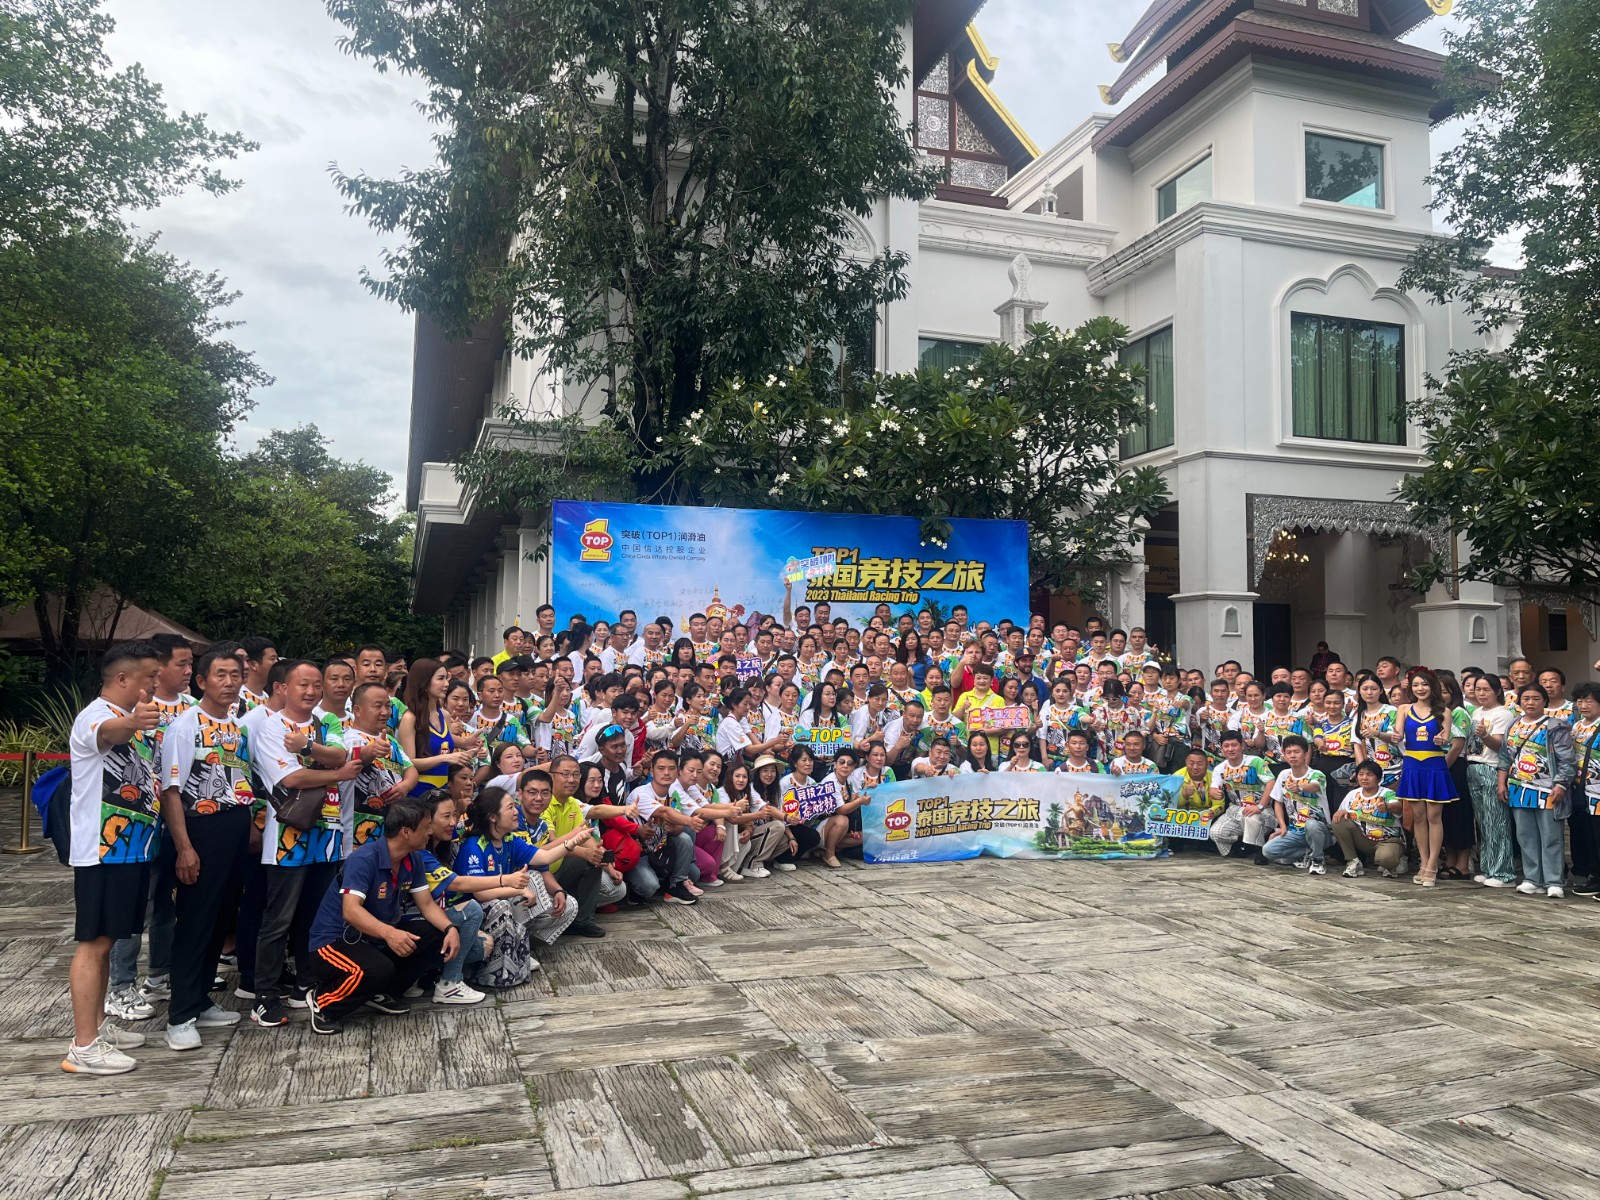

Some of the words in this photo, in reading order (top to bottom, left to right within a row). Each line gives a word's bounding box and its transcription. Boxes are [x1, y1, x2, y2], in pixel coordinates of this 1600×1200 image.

[585, 536, 609, 545] TOP
[806, 589, 829, 601] 2023
[831, 590, 869, 602] Thailand
[869, 591, 901, 603] Racing
[901, 591, 919, 603] Trip
[811, 729, 842, 743] TOP
[1375, 752, 1390, 760] TOP
[1519, 762, 1536, 771] TOP
[784, 803, 798, 812] TOP
[917, 796, 949, 811] TOP1
[916, 798, 1040, 828] 泰国竞技之旅
[1166, 810, 1199, 825] TOP
[887, 816, 909, 827] TOP
[915, 827, 932, 838] 2023
[932, 824, 957, 836] Thailand
